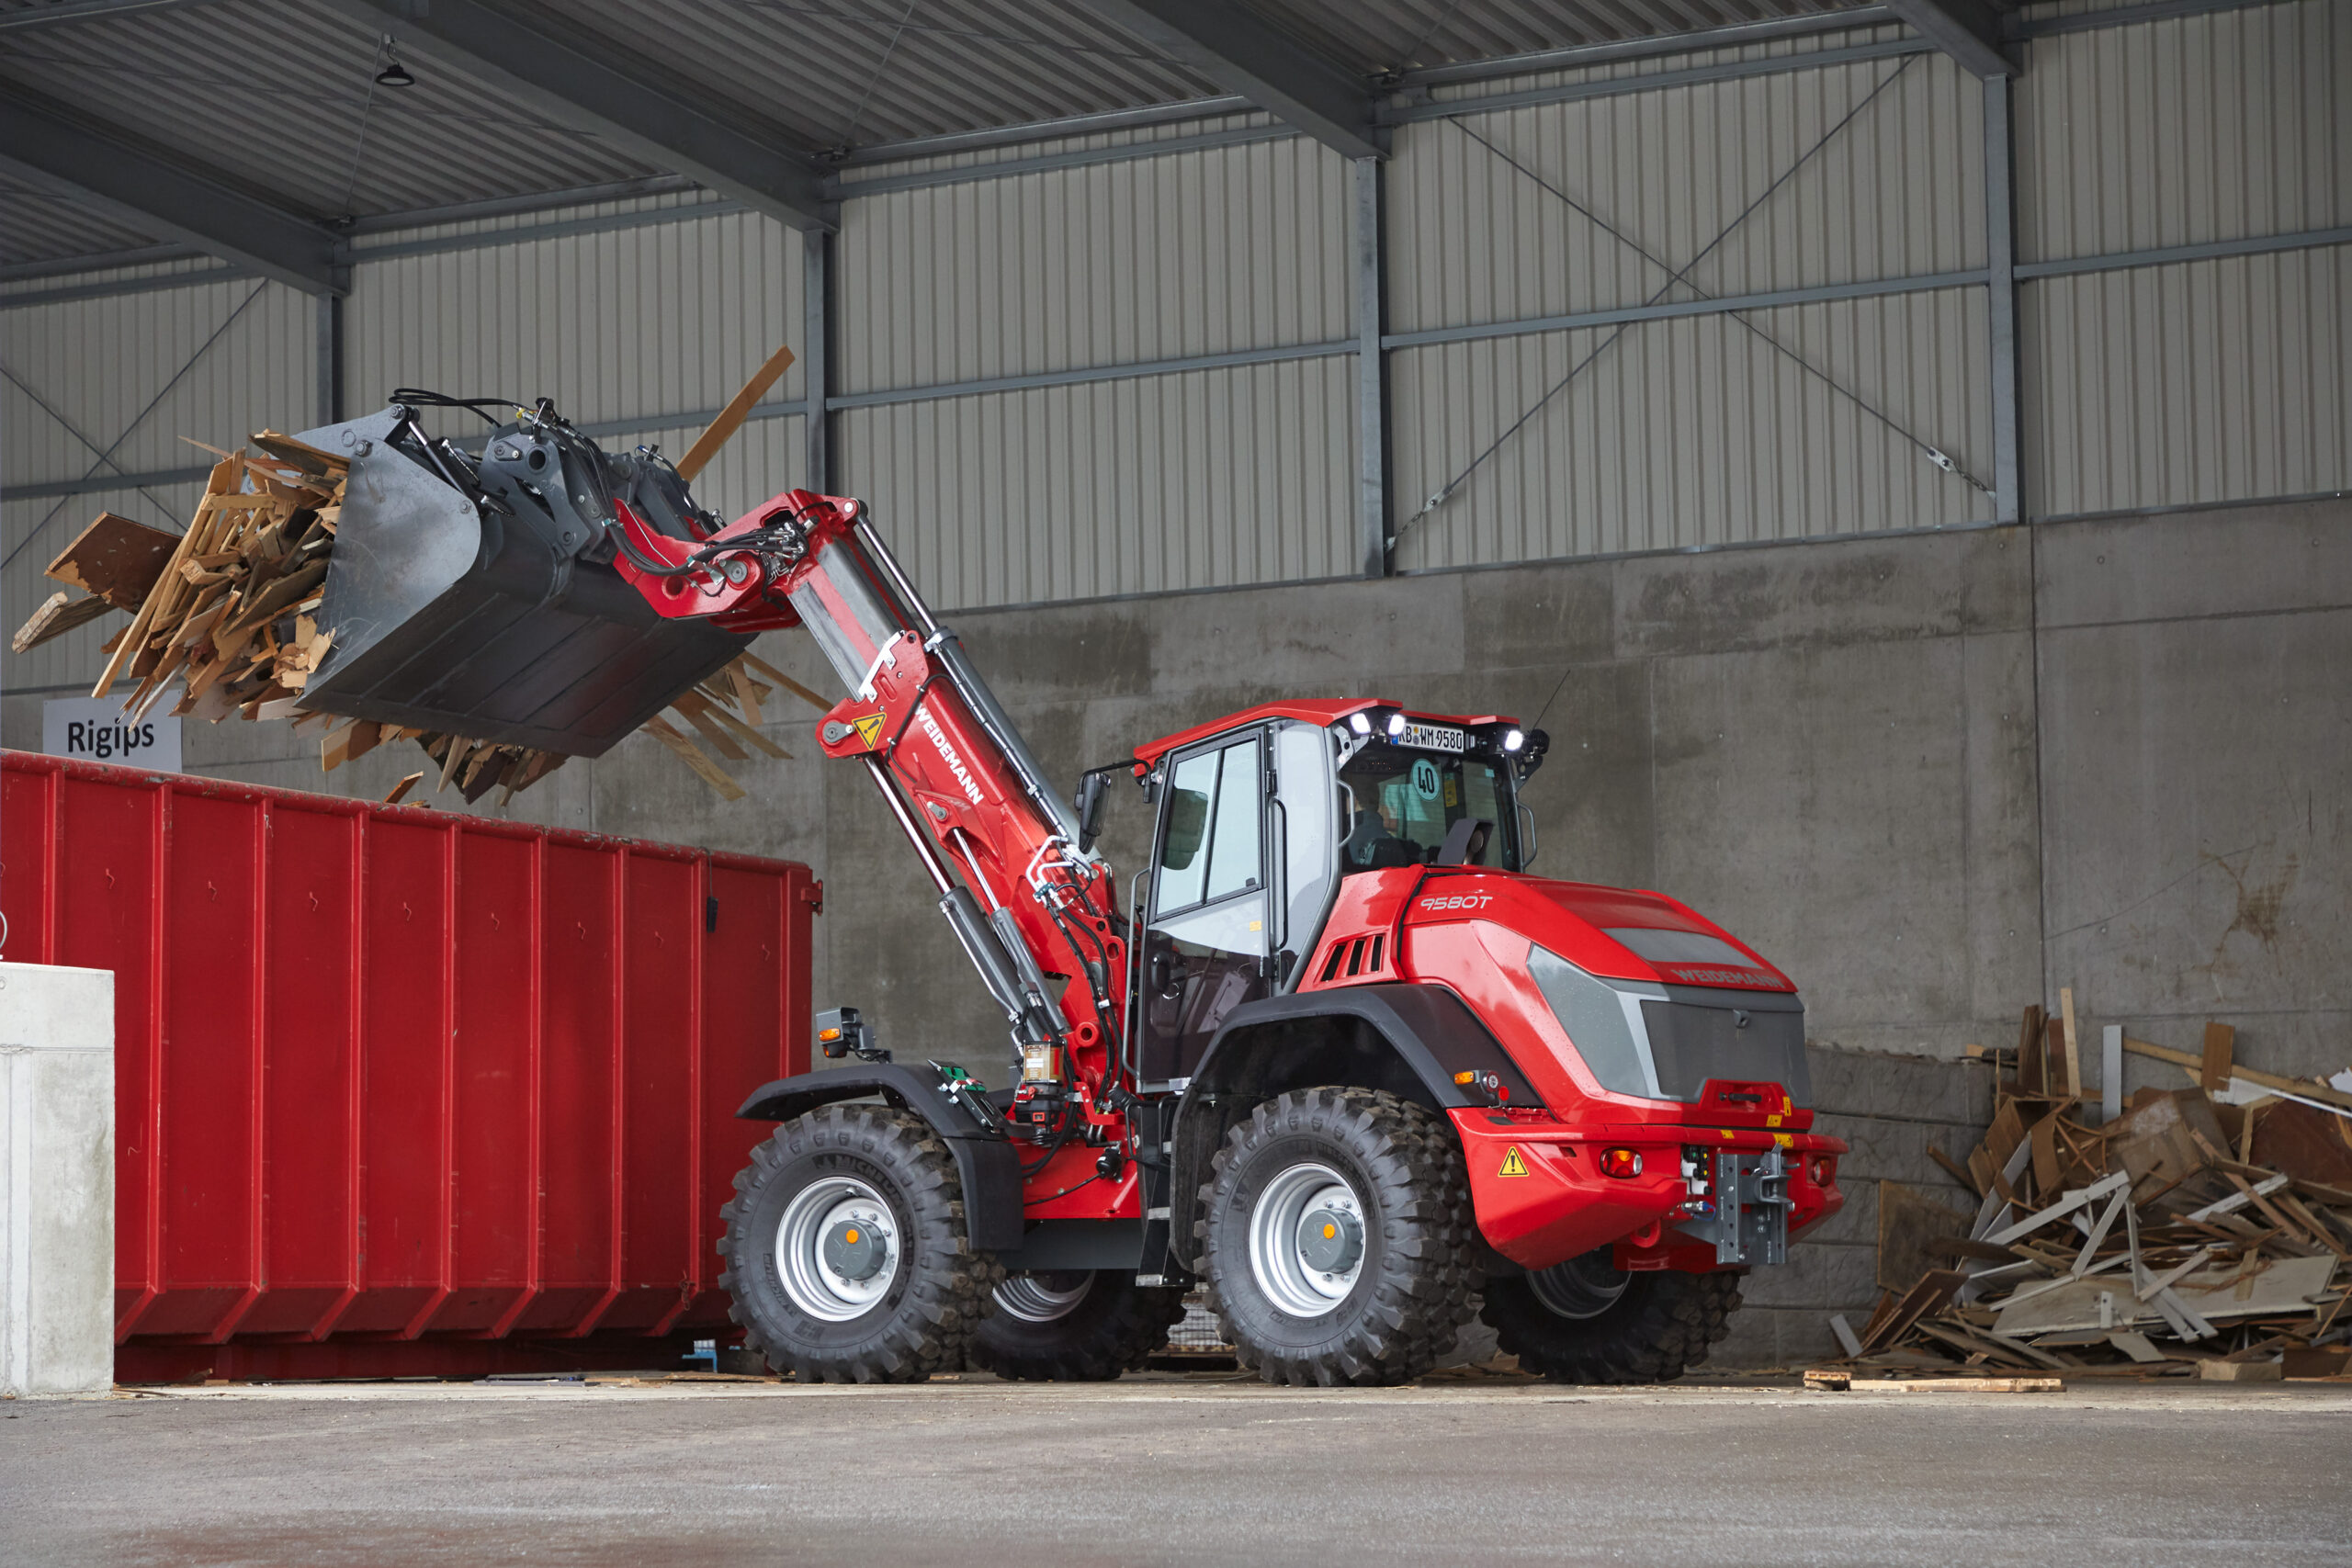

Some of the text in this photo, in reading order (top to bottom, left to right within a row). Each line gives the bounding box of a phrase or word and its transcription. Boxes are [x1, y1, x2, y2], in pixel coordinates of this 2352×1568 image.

[68, 717, 154, 758] Rigips
[1420, 728, 1433, 746] WM
[1436, 730, 1463, 750] 9580
[914, 703, 984, 806] WEIDEMANN
[1418, 765, 1435, 795] 40
[1420, 896, 1492, 910] 9580T
[1673, 969, 1785, 988] WEIDEMANN
